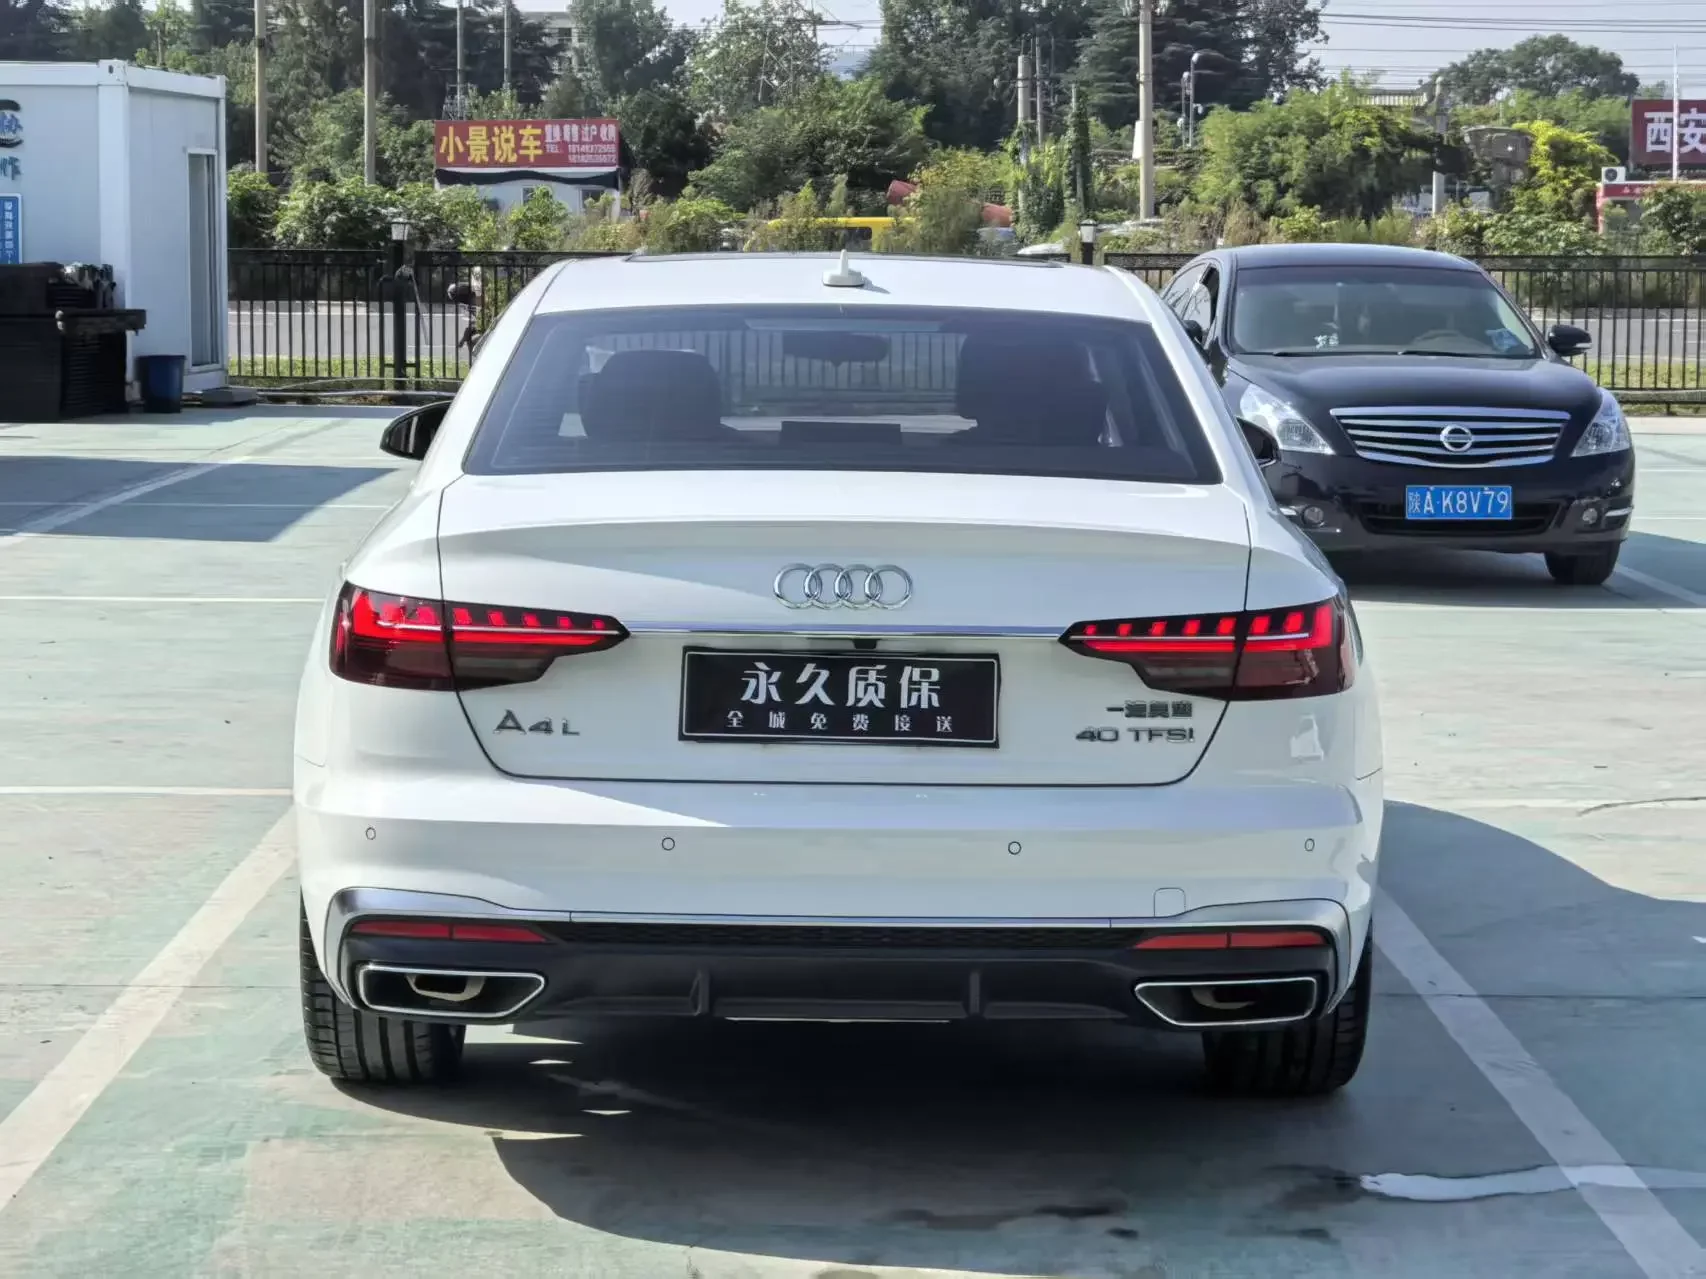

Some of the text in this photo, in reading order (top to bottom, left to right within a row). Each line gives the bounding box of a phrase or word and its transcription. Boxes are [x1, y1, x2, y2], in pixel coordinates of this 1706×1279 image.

[439, 125, 543, 163] 小景说车
[1643, 108, 1706, 154] 西安
[740, 661, 941, 709] 永久质保
[727, 710, 953, 733] 全城免费接送
[1075, 726, 1195, 742] 40 TFSI
